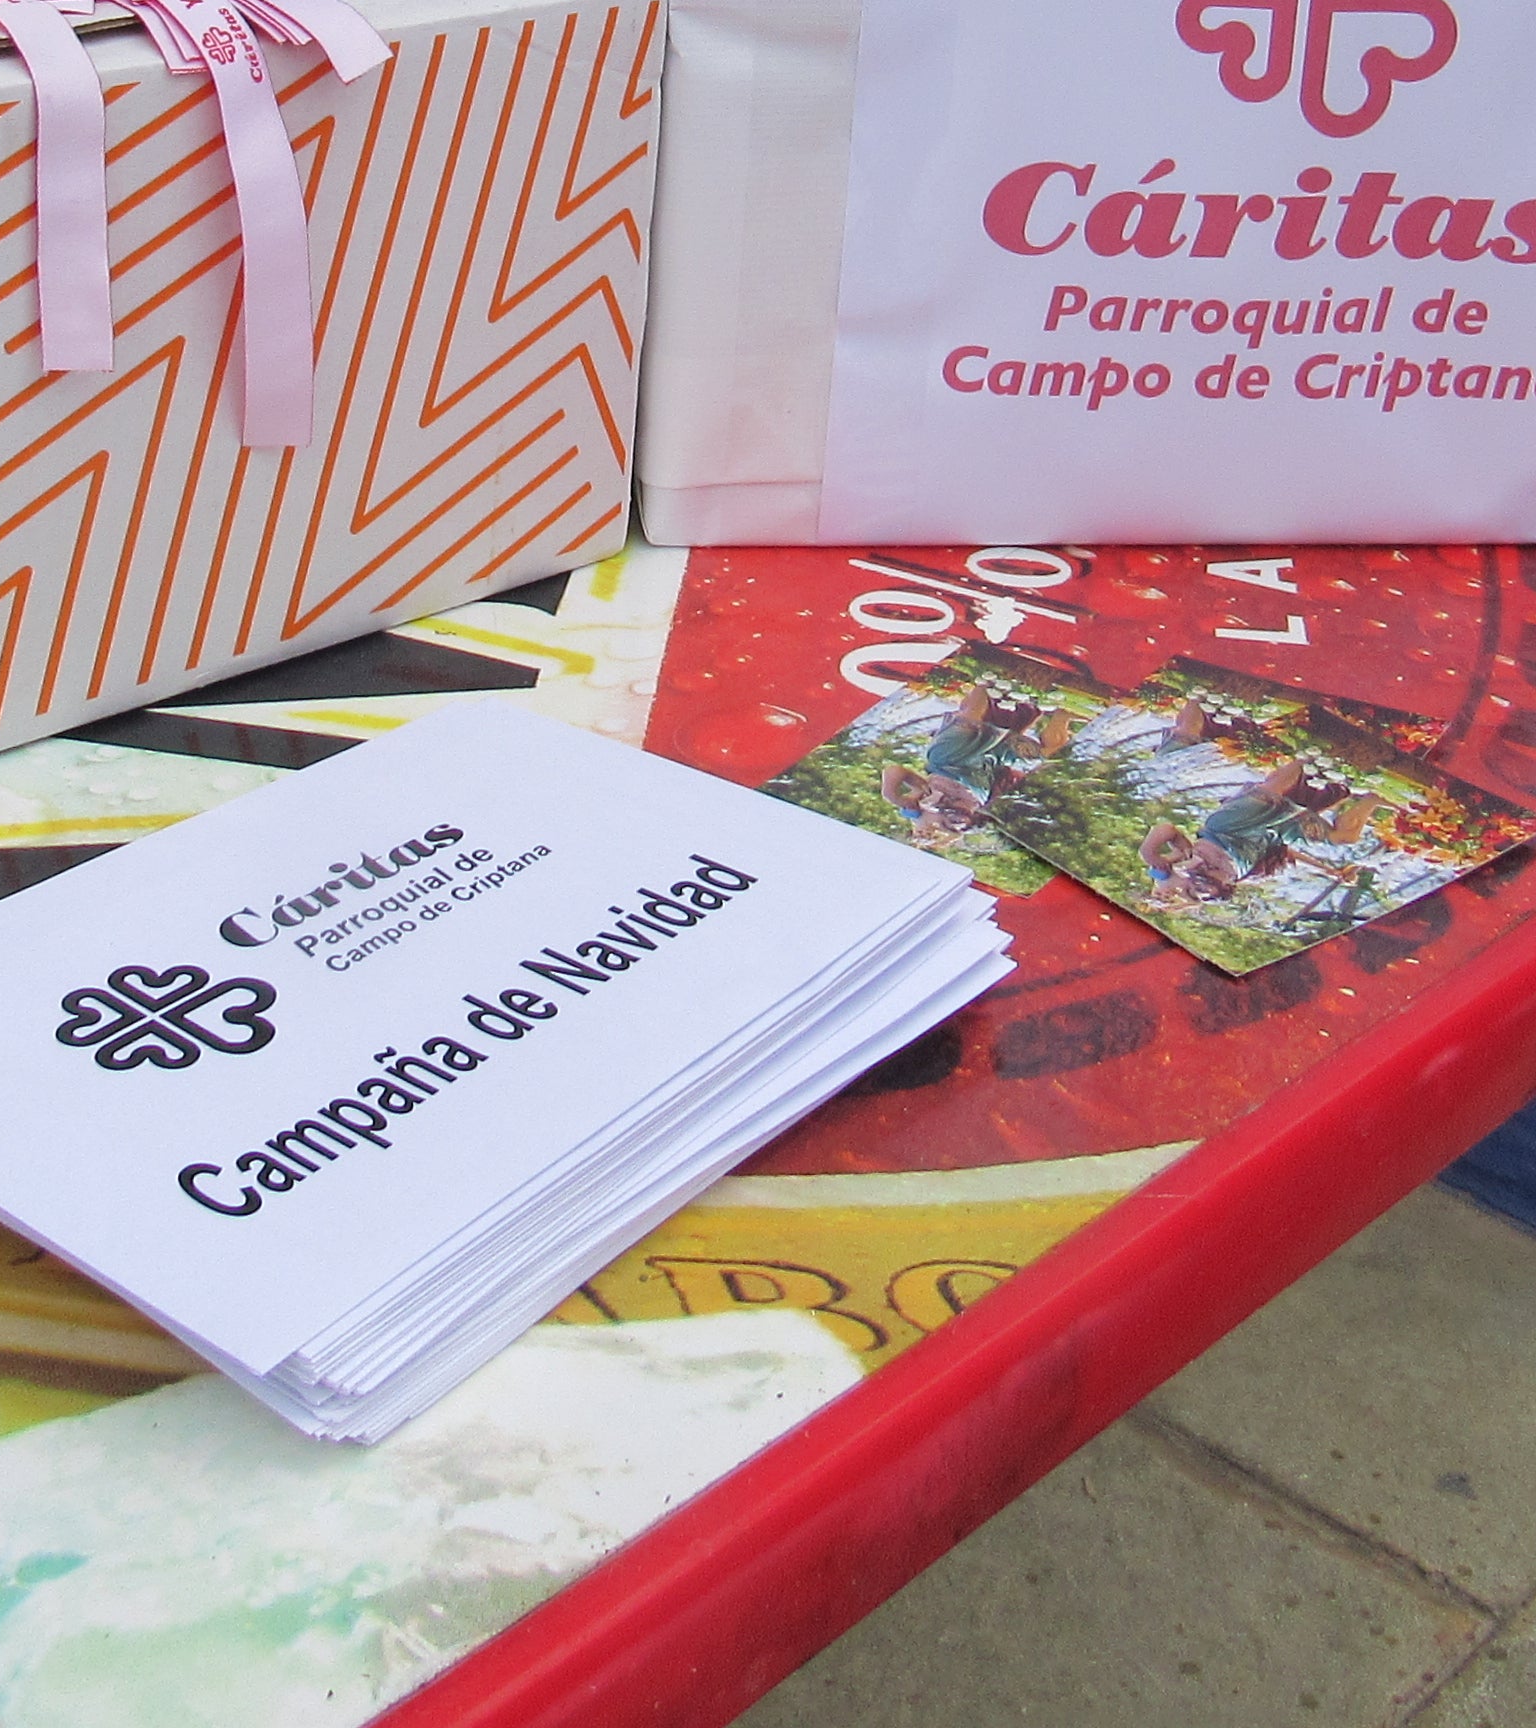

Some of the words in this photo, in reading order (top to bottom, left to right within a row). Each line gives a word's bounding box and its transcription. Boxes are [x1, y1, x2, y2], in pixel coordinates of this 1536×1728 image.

[1042, 285, 1394, 349] Parroquial
[1411, 288, 1489, 335] de
[941, 346, 1172, 411] Campo
[1193, 355, 1271, 400] de
[219, 823, 464, 947] Cáritas
[294, 867, 454, 958] Parroquial
[454, 847, 494, 873] de
[325, 920, 418, 973] Campo
[419, 900, 454, 923] de
[449, 843, 552, 902] Criptana
[177, 1034, 490, 1217] Campaña
[462, 988, 560, 1042] de
[518, 854, 759, 996] Navidad
